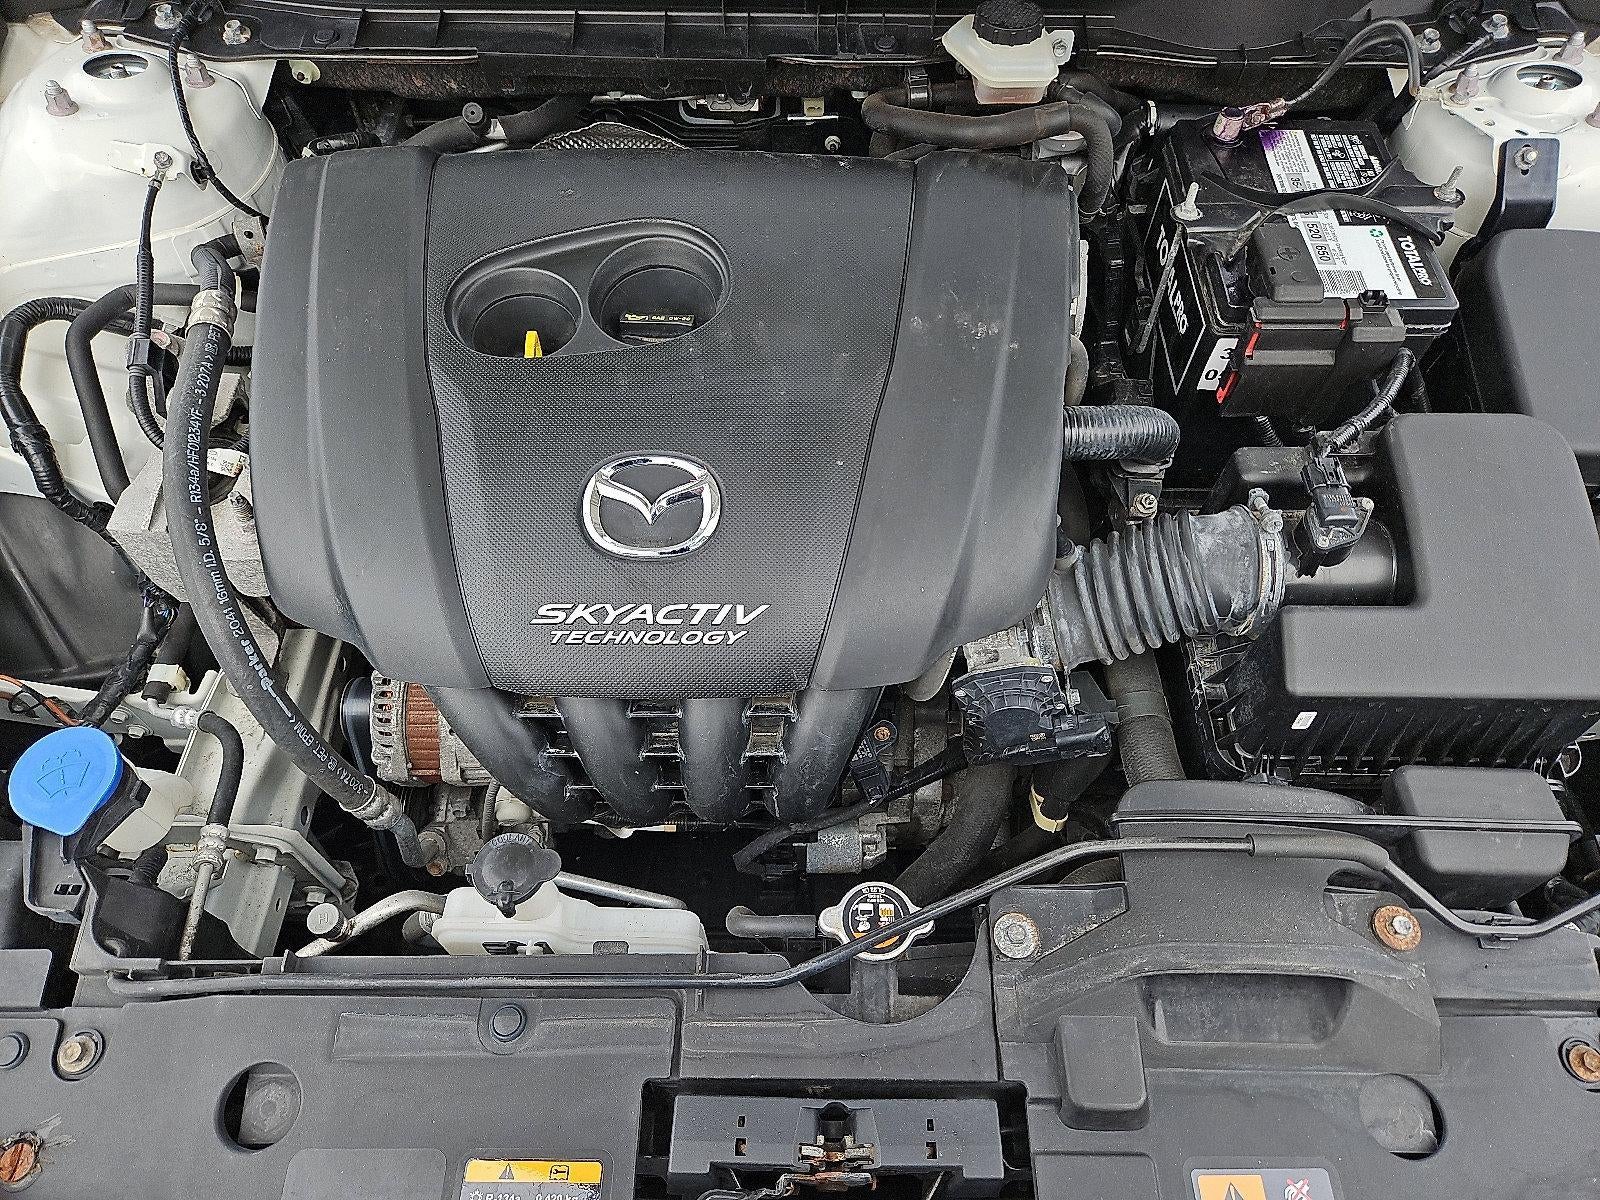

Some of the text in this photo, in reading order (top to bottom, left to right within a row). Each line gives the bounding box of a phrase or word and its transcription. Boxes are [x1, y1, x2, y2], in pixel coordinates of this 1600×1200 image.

[1307, 223, 1322, 239] 520
[1315, 245, 1331, 262] 650
[1398, 235, 1432, 287] TOTALPRO
[211, 570, 229, 604] 16mm
[223, 606, 245, 638] 2041
[529, 603, 771, 626] SKYACTIV
[550, 630, 749, 646] TECHNOLOGY
[241, 639, 273, 691] Parker
